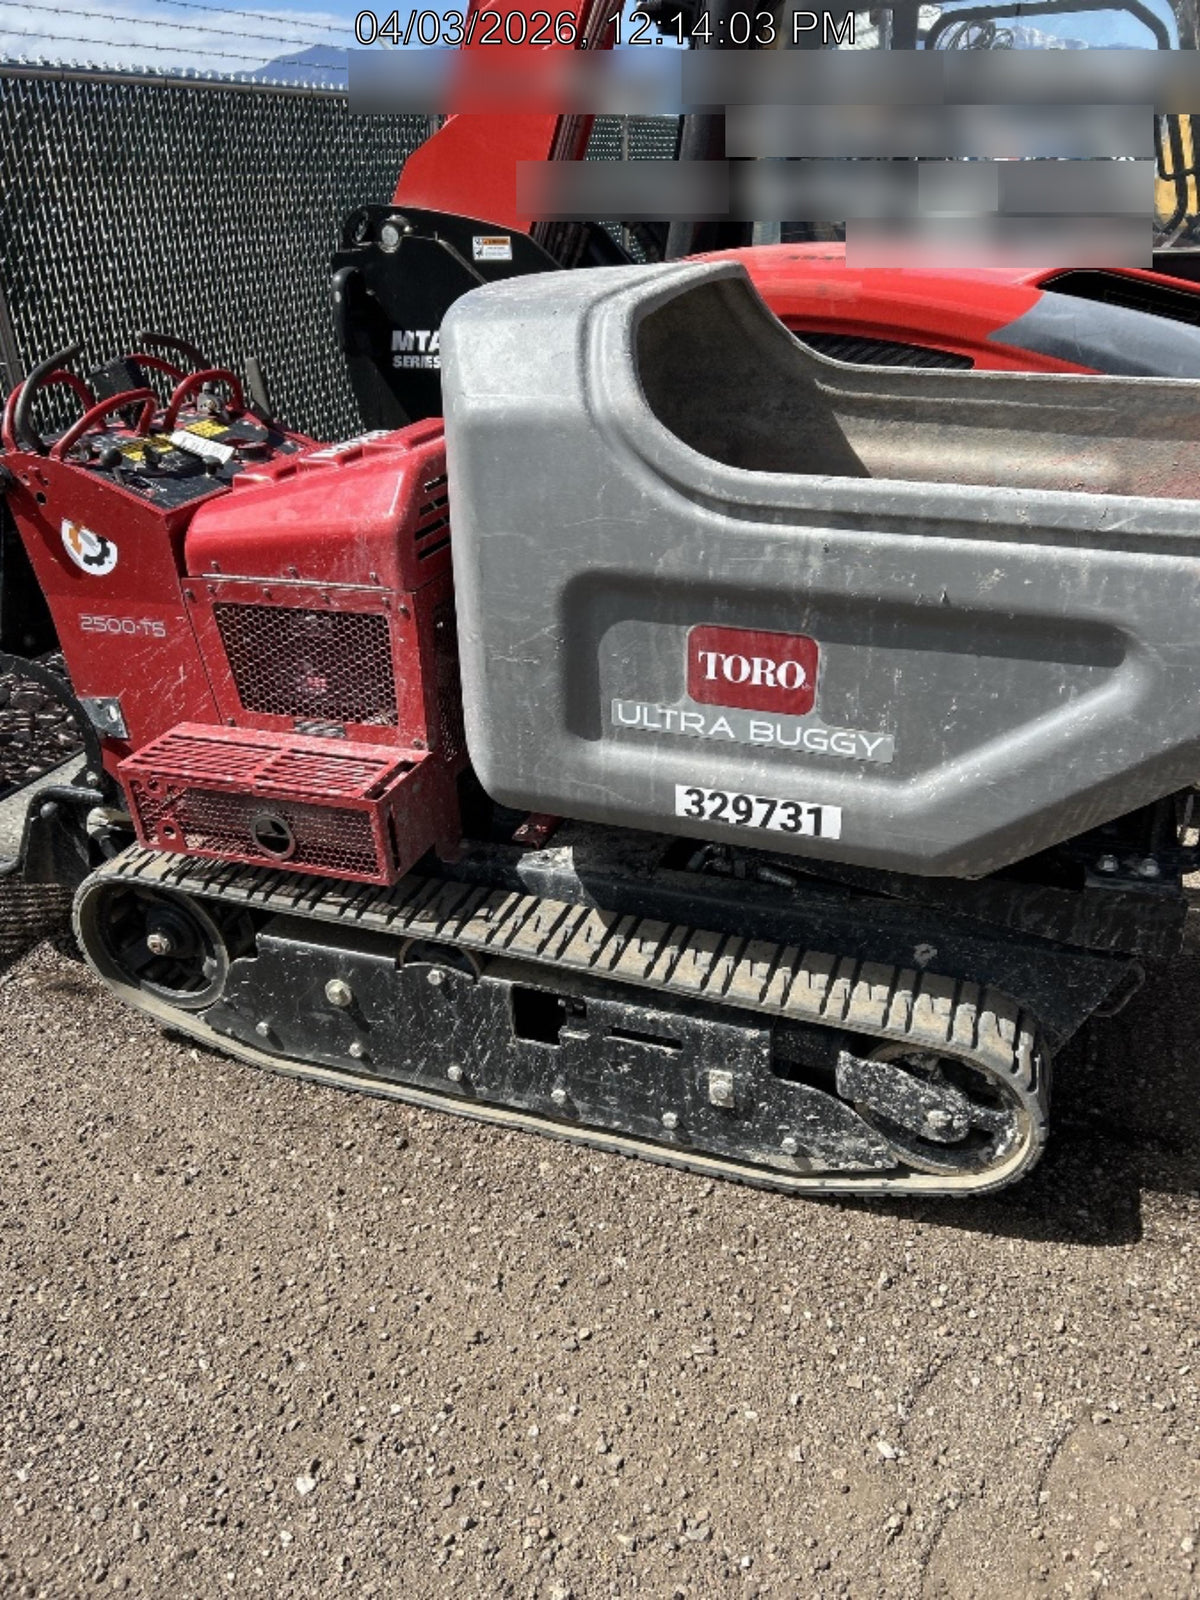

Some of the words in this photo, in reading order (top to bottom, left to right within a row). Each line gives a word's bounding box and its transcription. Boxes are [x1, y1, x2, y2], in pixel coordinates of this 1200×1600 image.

[393, 355, 441, 369] SERIES
[698, 650, 807, 690] TORO
[617, 702, 736, 739] ULTRA
[749, 719, 884, 757] BUGGY
[683, 788, 823, 837] 329731
